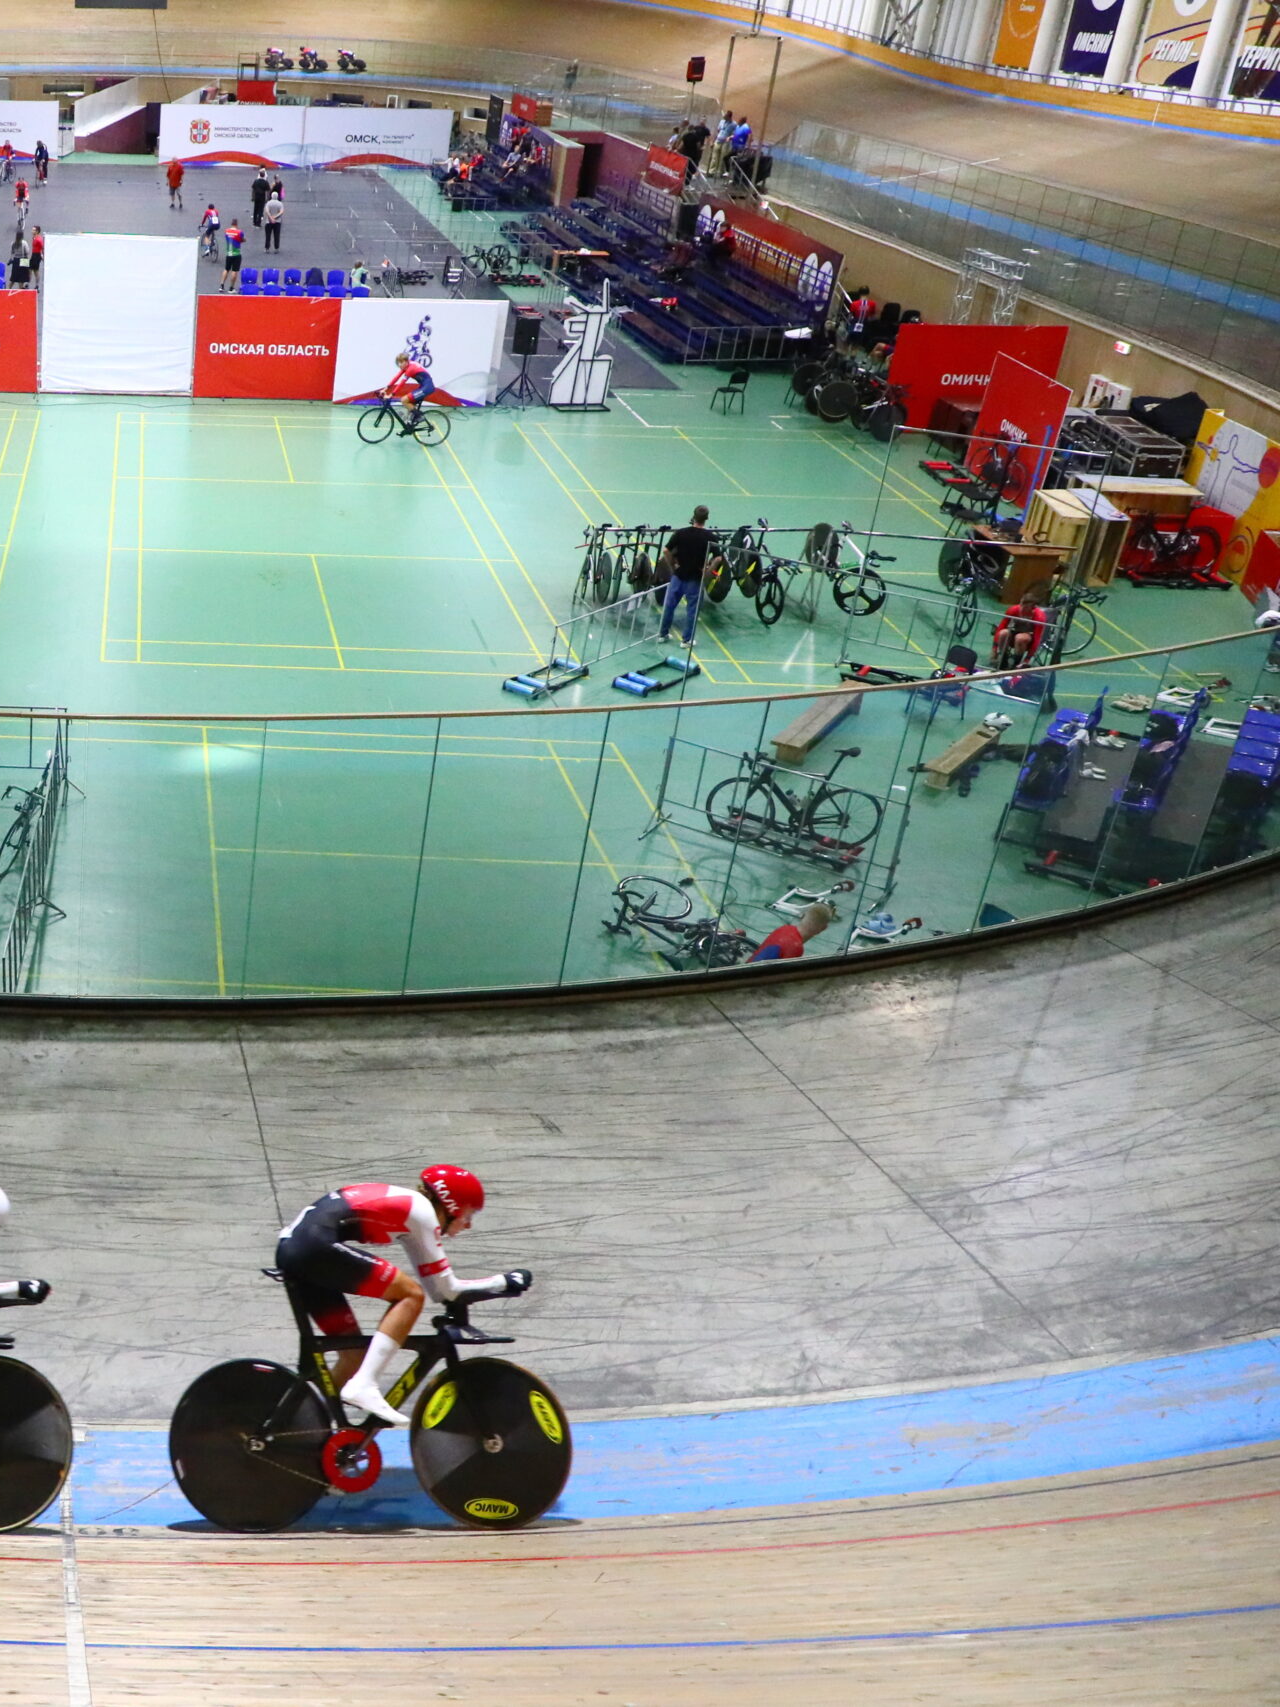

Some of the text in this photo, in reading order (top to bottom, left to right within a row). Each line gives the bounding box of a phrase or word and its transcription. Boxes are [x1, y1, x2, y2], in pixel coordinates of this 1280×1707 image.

[345, 134, 381, 144] ОМСК,
[209, 342, 330, 357] ОМСКАЯ ОБЛАСТЬ
[941, 373, 991, 386] ОМИЧК
[474, 1503, 509, 1514] MAVIC
